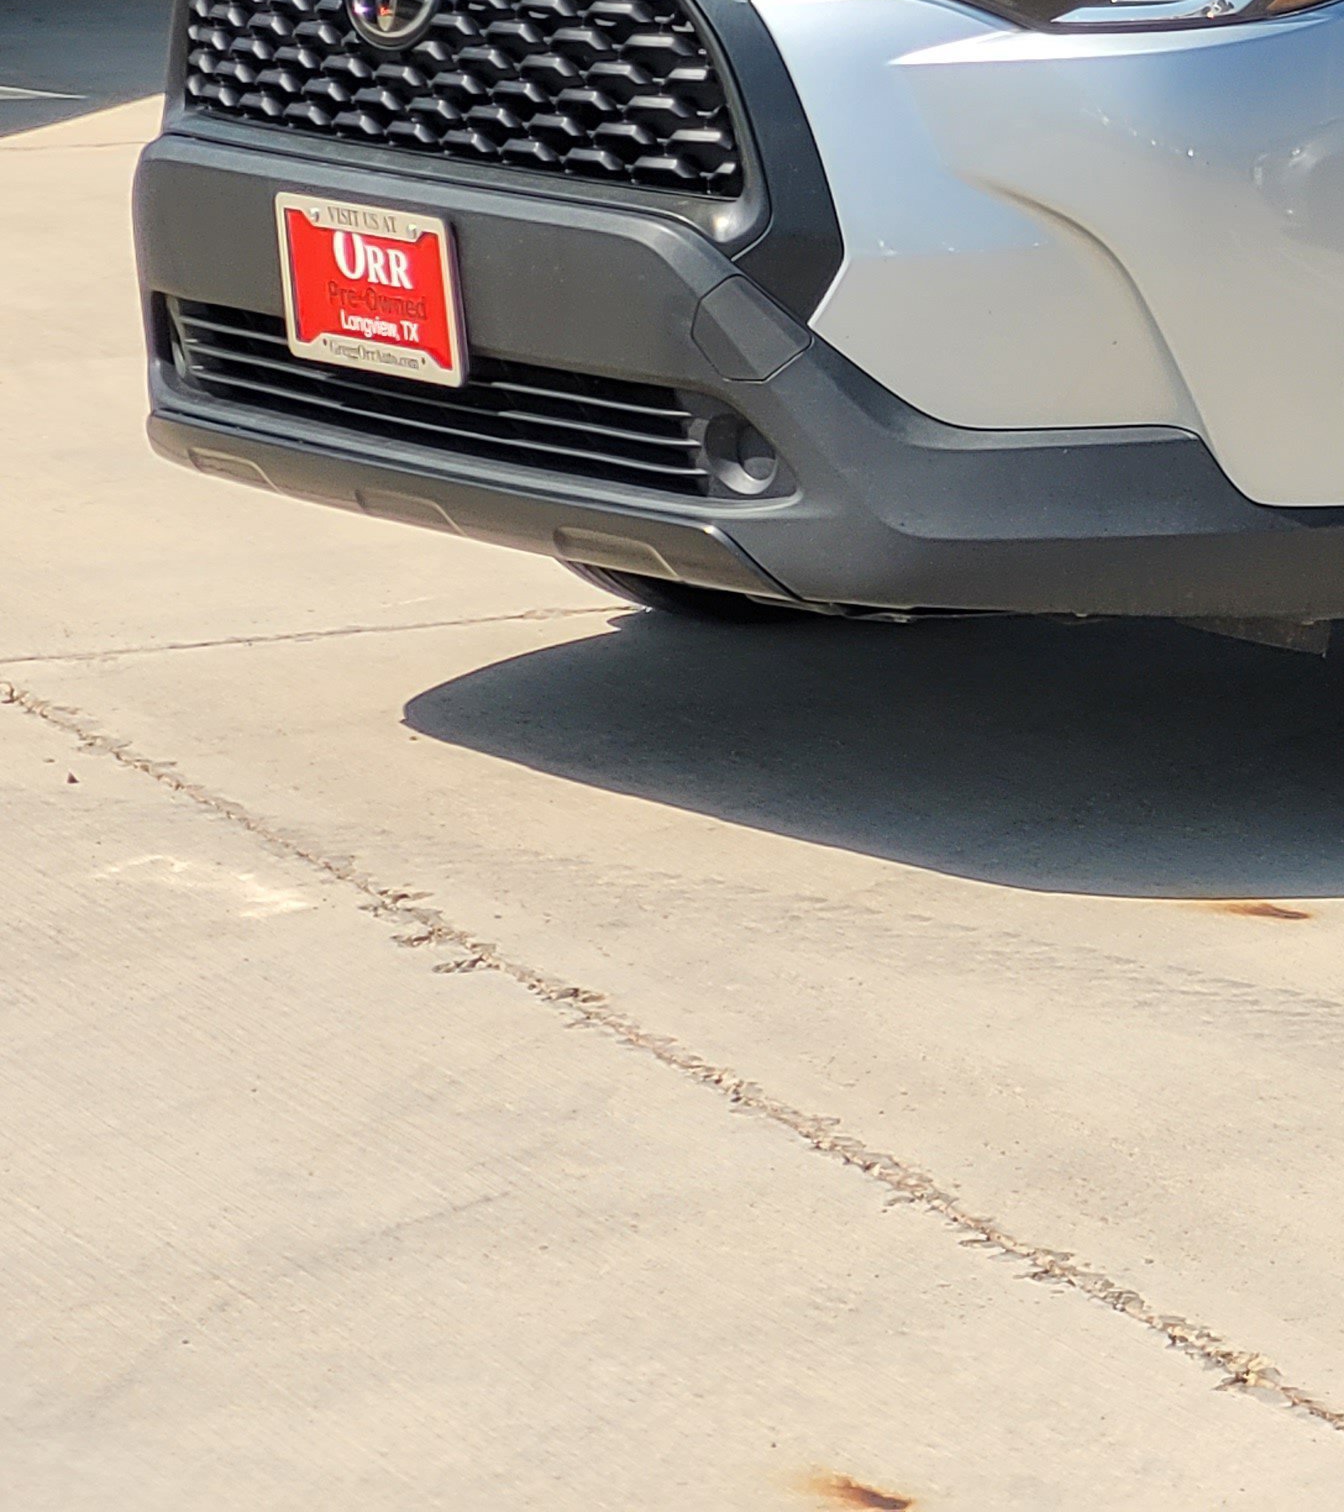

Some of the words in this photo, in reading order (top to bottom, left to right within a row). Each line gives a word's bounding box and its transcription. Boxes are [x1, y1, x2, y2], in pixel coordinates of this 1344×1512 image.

[327, 206, 359, 227] VISIT
[362, 212, 379, 230] US
[382, 215, 398, 233] AT
[328, 280, 428, 320] Pre-Owned
[340, 309, 401, 341] Longview,
[401, 320, 420, 343] TX
